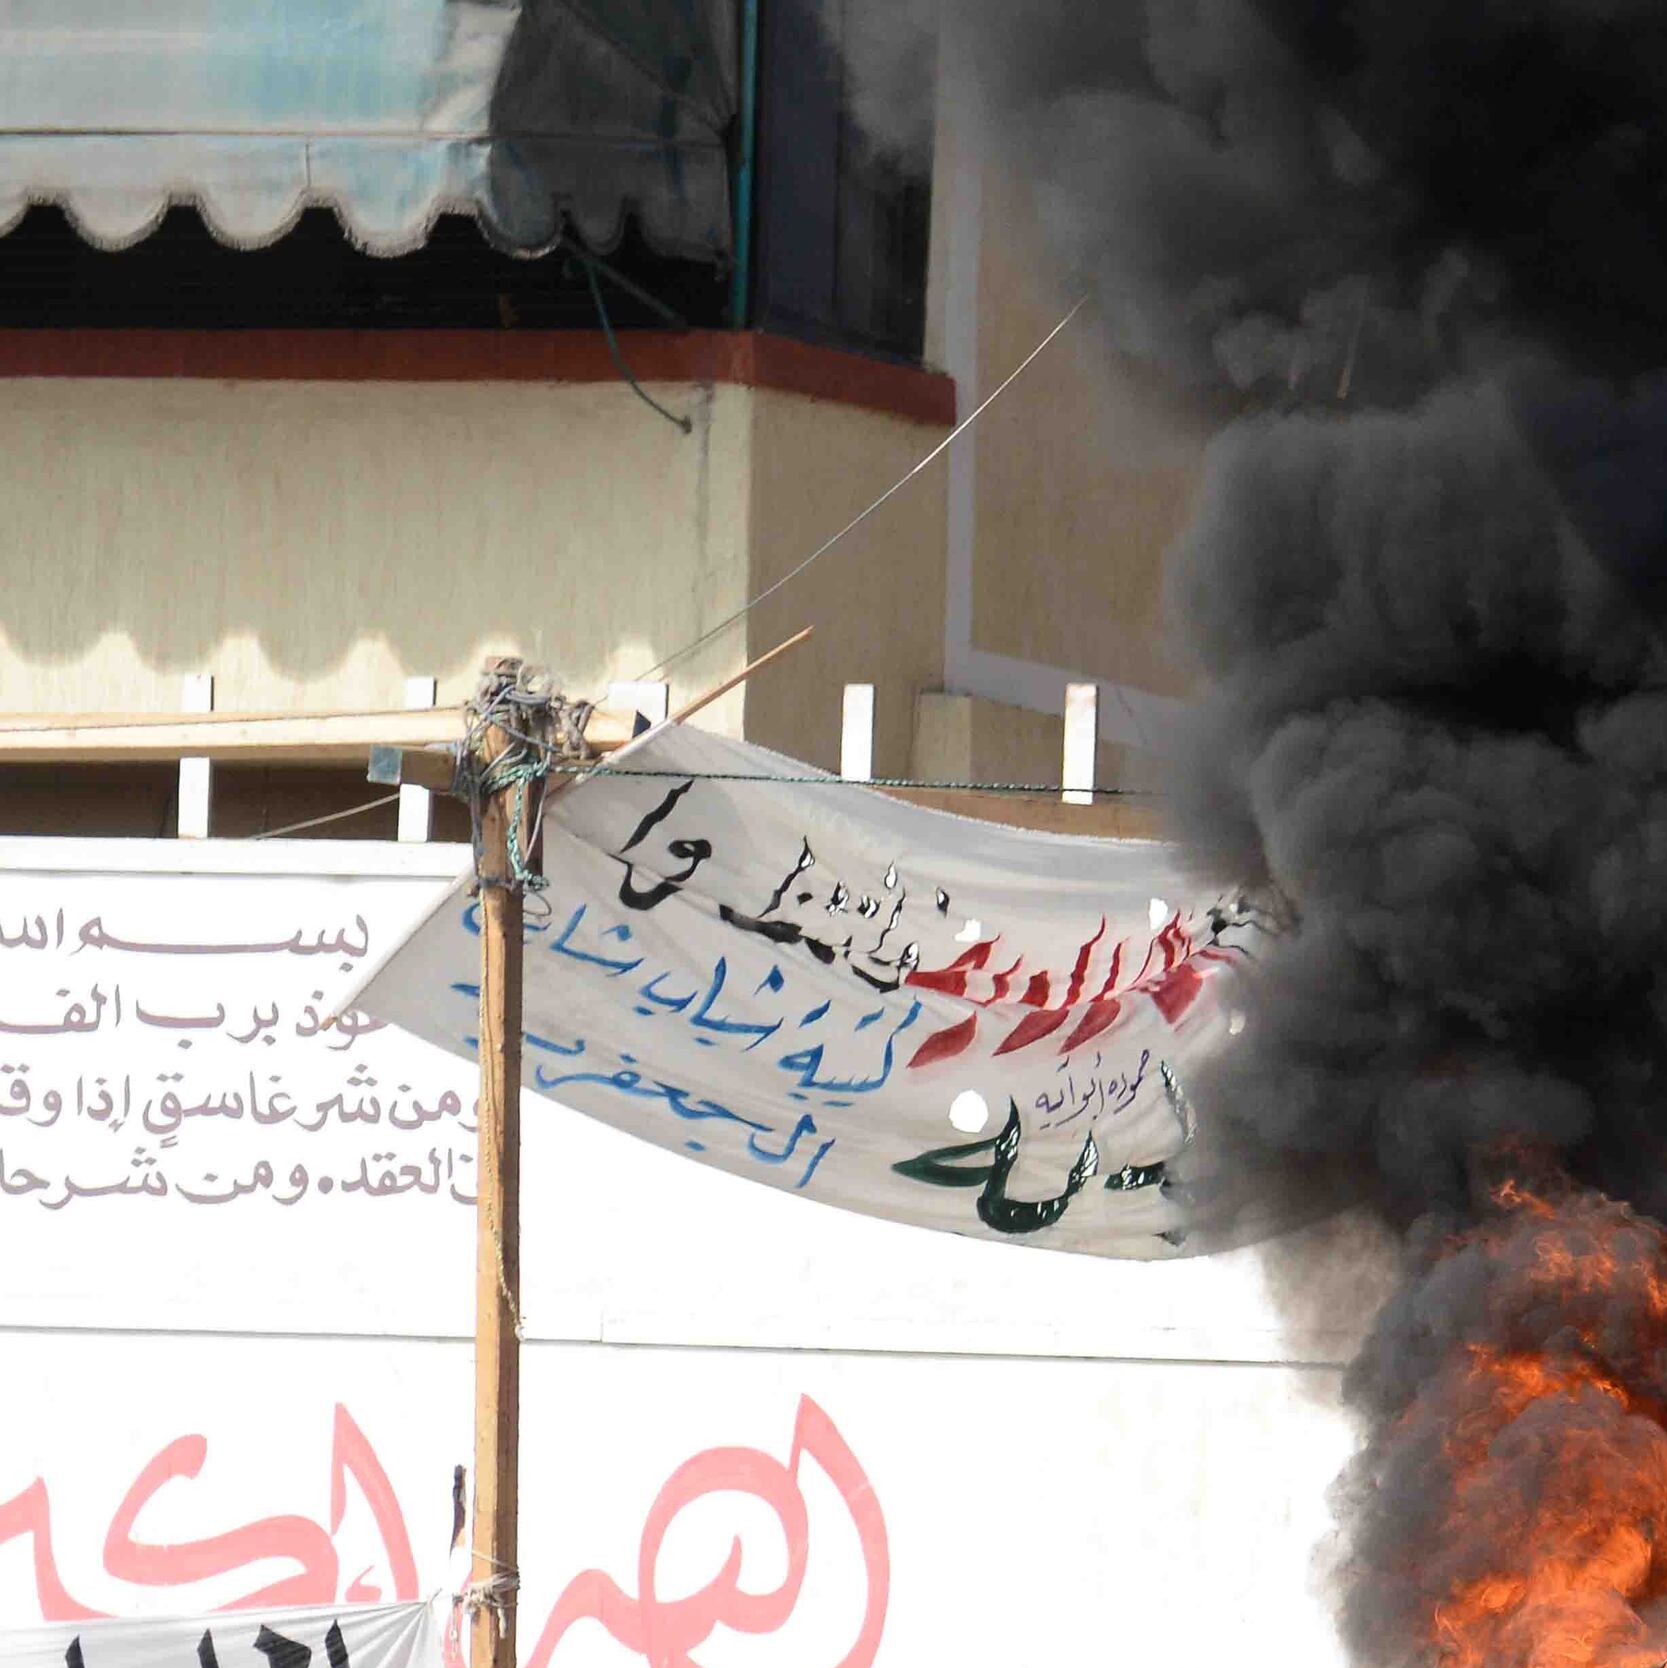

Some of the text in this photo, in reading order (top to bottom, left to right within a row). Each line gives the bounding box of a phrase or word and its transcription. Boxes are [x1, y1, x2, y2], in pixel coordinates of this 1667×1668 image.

[0, 906, 370, 972] بسم الل
[293, 1063, 382, 1133] شر
[38, 1146, 169, 1211] شر
[175, 1159, 310, 1206] ومن
